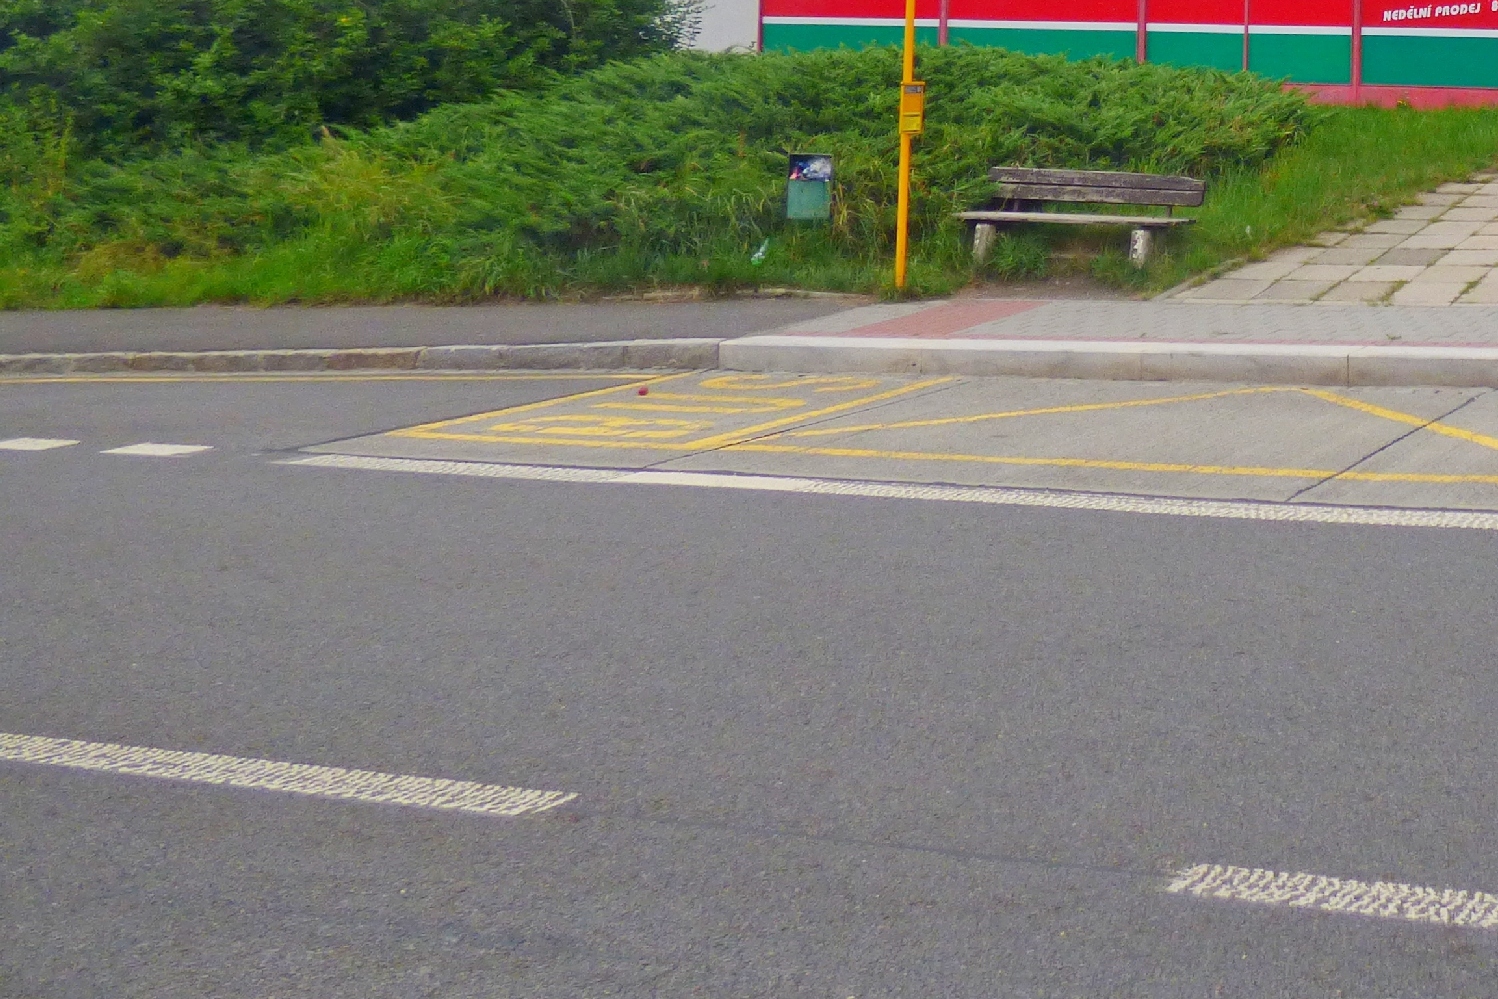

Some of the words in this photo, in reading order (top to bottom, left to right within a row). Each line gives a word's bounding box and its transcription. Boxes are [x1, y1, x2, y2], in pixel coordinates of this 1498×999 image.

[1383, 4, 1432, 22] NEDĚLNÍ
[1435, 2, 1481, 17] PRODEJ
[490, 375, 883, 438] BUS
